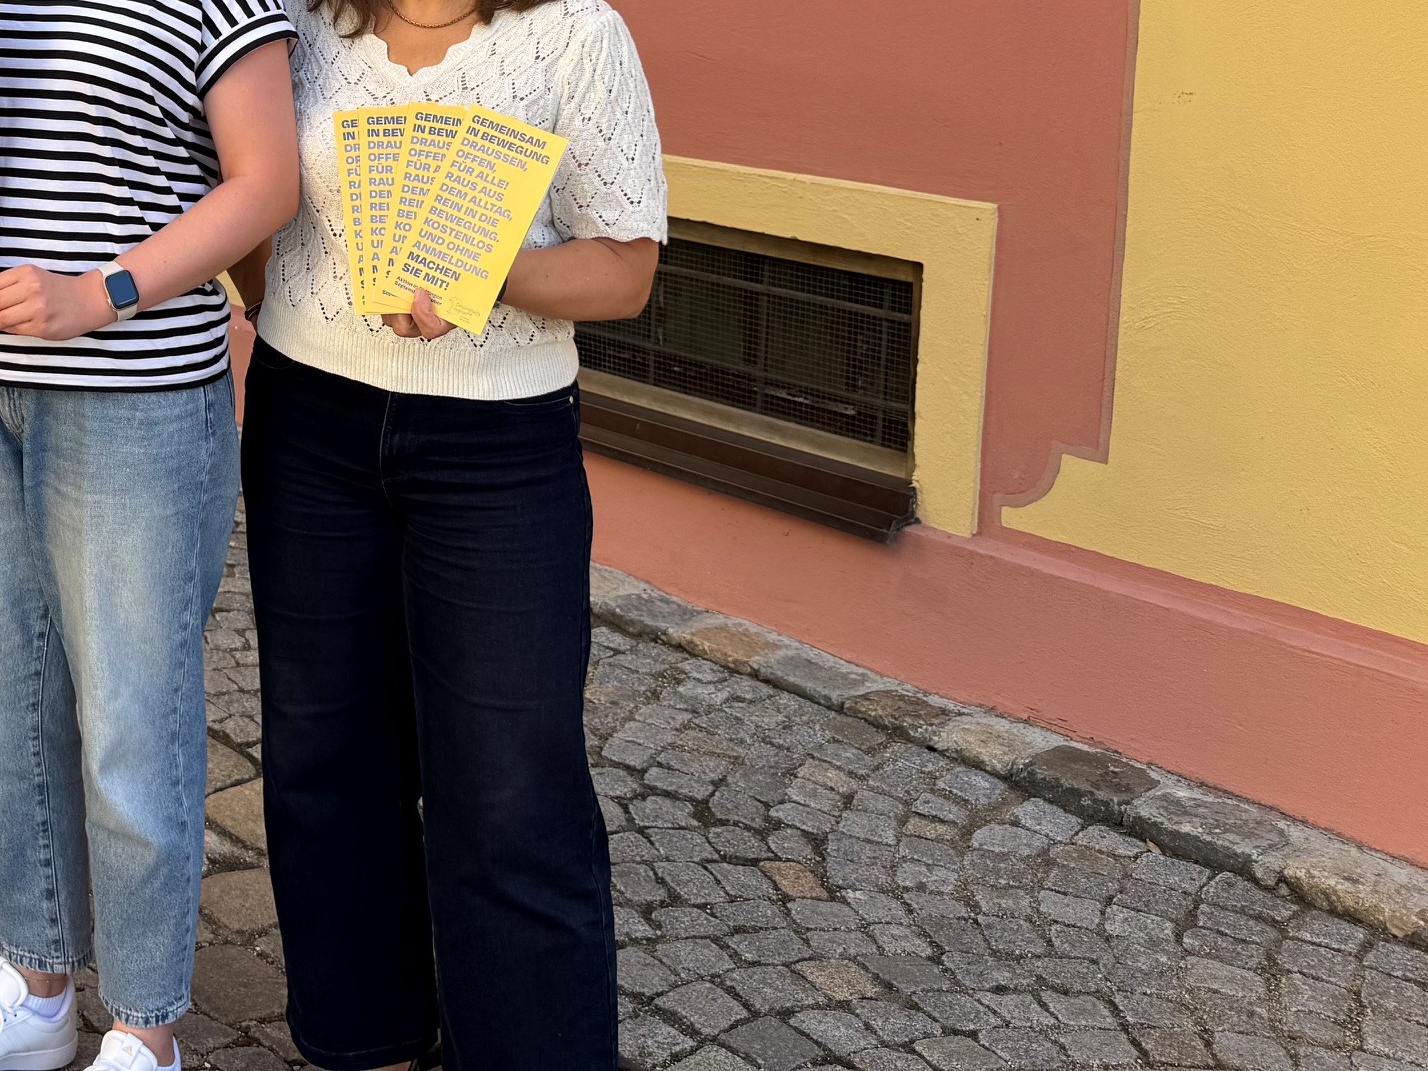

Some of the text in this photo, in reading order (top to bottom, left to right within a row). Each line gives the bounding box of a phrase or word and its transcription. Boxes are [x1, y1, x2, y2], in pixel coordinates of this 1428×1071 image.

[367, 129, 379, 137] IN
[413, 124, 426, 133] IN
[472, 115, 547, 149] GEMEINSAM
[456, 149, 497, 173] OFFEN,
[461, 137, 528, 172] DRAUSSEN,
[466, 126, 550, 165] IN BEWEGUNG
[369, 163, 393, 174] FÜR
[406, 159, 431, 172] FÜR
[450, 160, 475, 176] FÜR
[475, 170, 509, 190] ALLE!
[440, 183, 513, 221] DEM ALLTAG,
[445, 171, 505, 202] RAUS AUS
[429, 205, 499, 242] BEWEGUNG.
[434, 194, 500, 227] REIN IN DIE
[419, 228, 445, 246] UND
[447, 241, 481, 262] OHNE
[423, 217, 494, 253] KOSTENLOS
[407, 251, 461, 281] MACHEN
[412, 241, 489, 280] ANMELDUNG
[396, 276, 413, 286] Aktion
[402, 263, 450, 291] SIE MIT!
